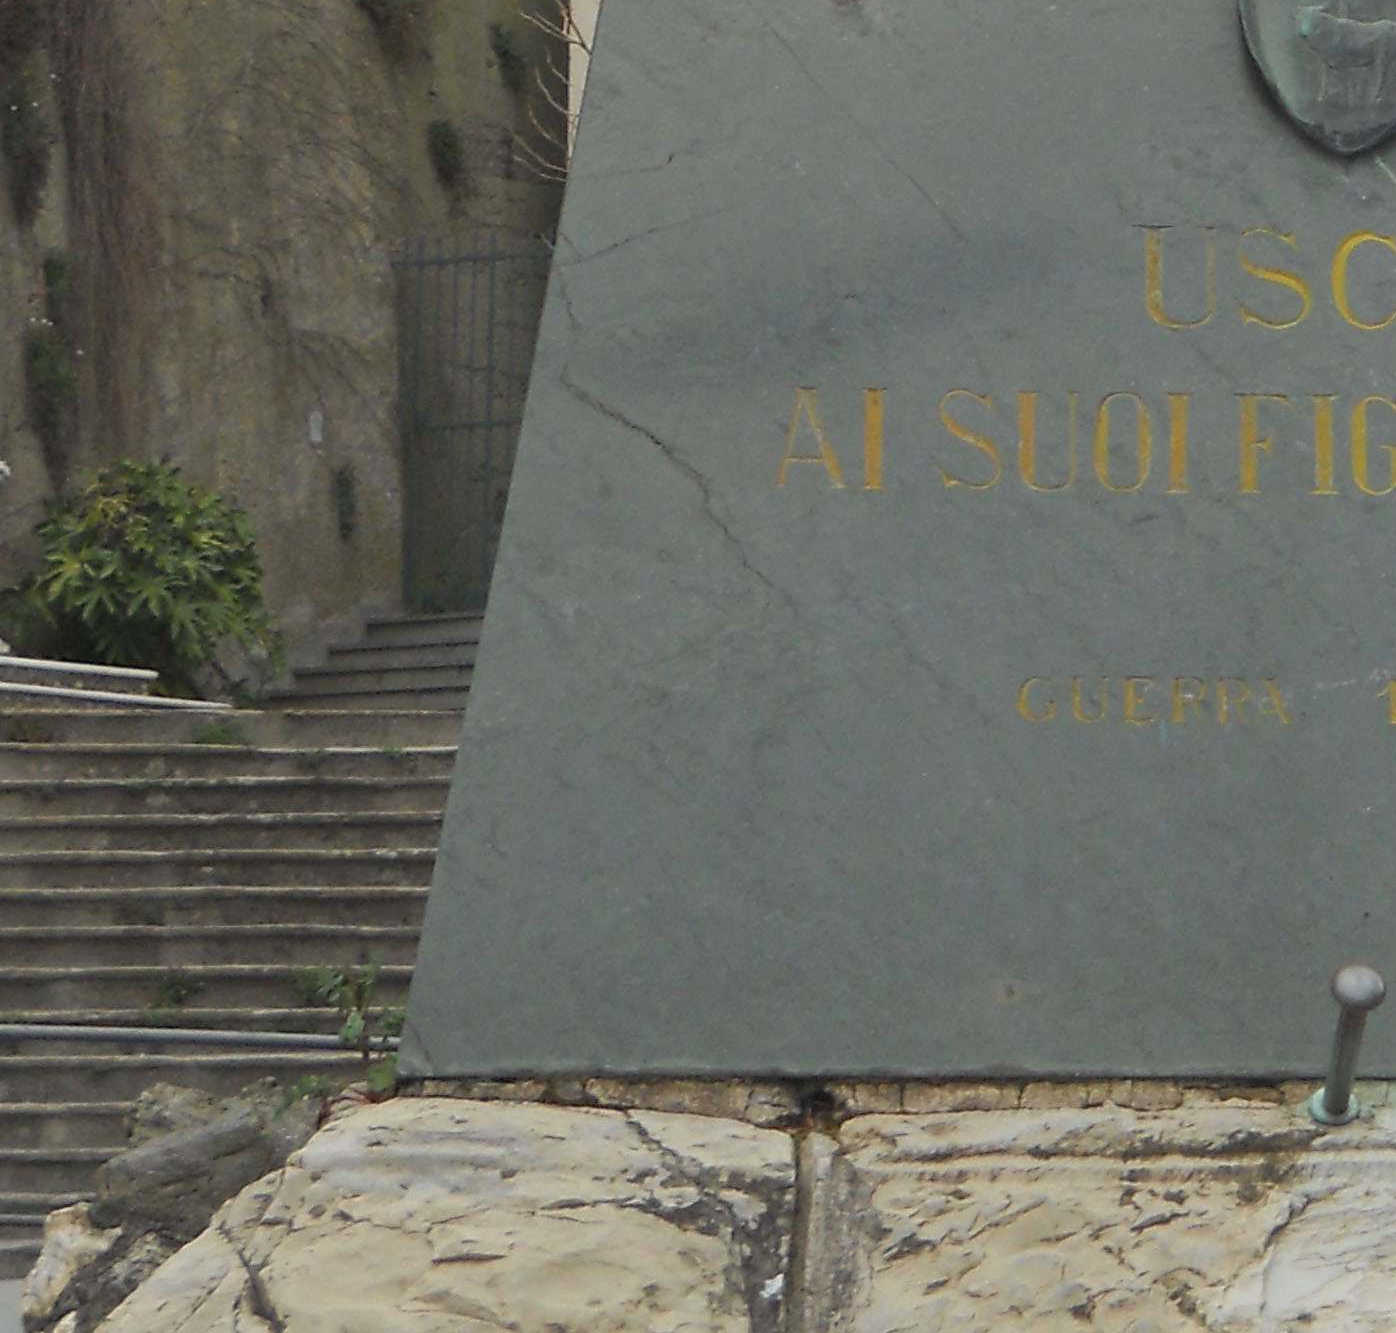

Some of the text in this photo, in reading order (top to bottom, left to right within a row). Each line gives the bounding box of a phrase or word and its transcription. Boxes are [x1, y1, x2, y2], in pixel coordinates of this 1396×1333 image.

[774, 386, 887, 491] AI
[929, 388, 1195, 494] SUOI
[1015, 674, 1294, 727] GUERRA
